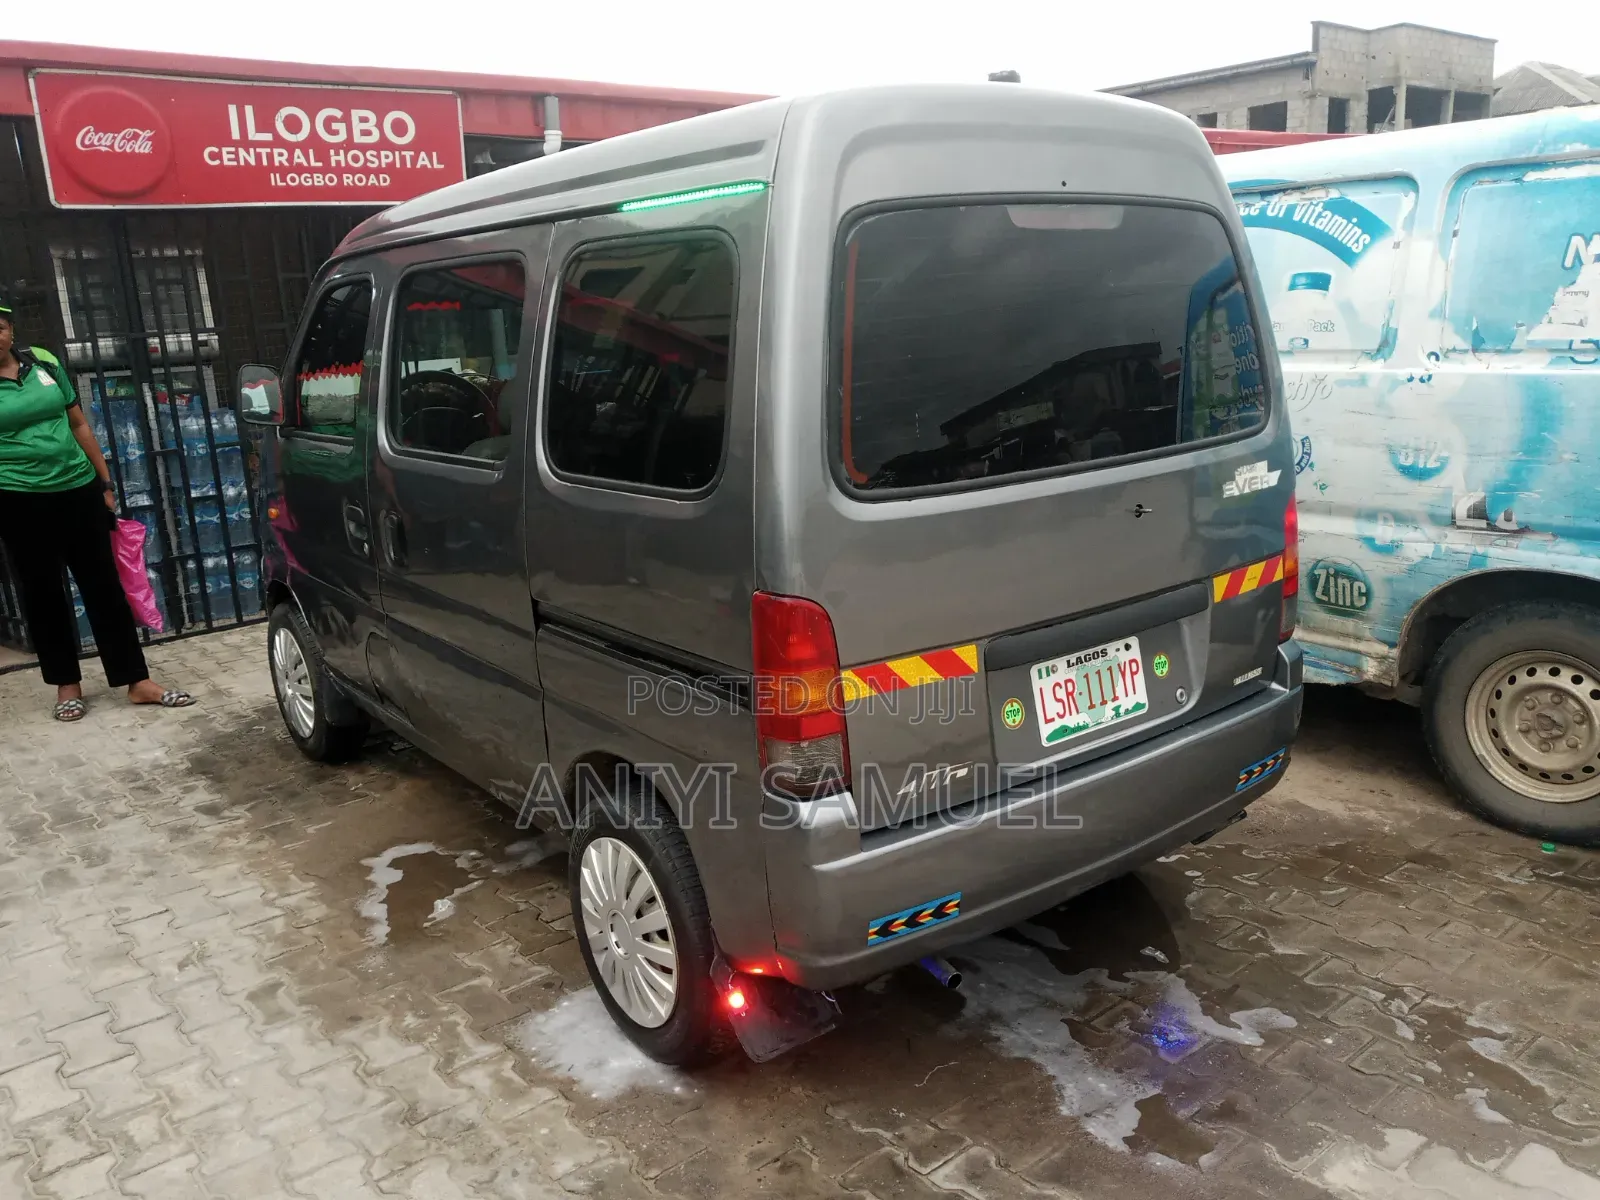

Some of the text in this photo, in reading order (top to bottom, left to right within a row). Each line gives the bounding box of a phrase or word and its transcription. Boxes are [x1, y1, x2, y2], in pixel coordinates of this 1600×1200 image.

[227, 104, 417, 145] ILOGBO
[203, 146, 445, 169] CENTRAL HOSPITAL
[270, 173, 391, 187] ILOGBO ROAD
[1314, 567, 1367, 608] Zinc
[1066, 648, 1108, 668] LAGOS
[1154, 660, 1167, 671] STOP
[1005, 706, 1020, 719] STOP
